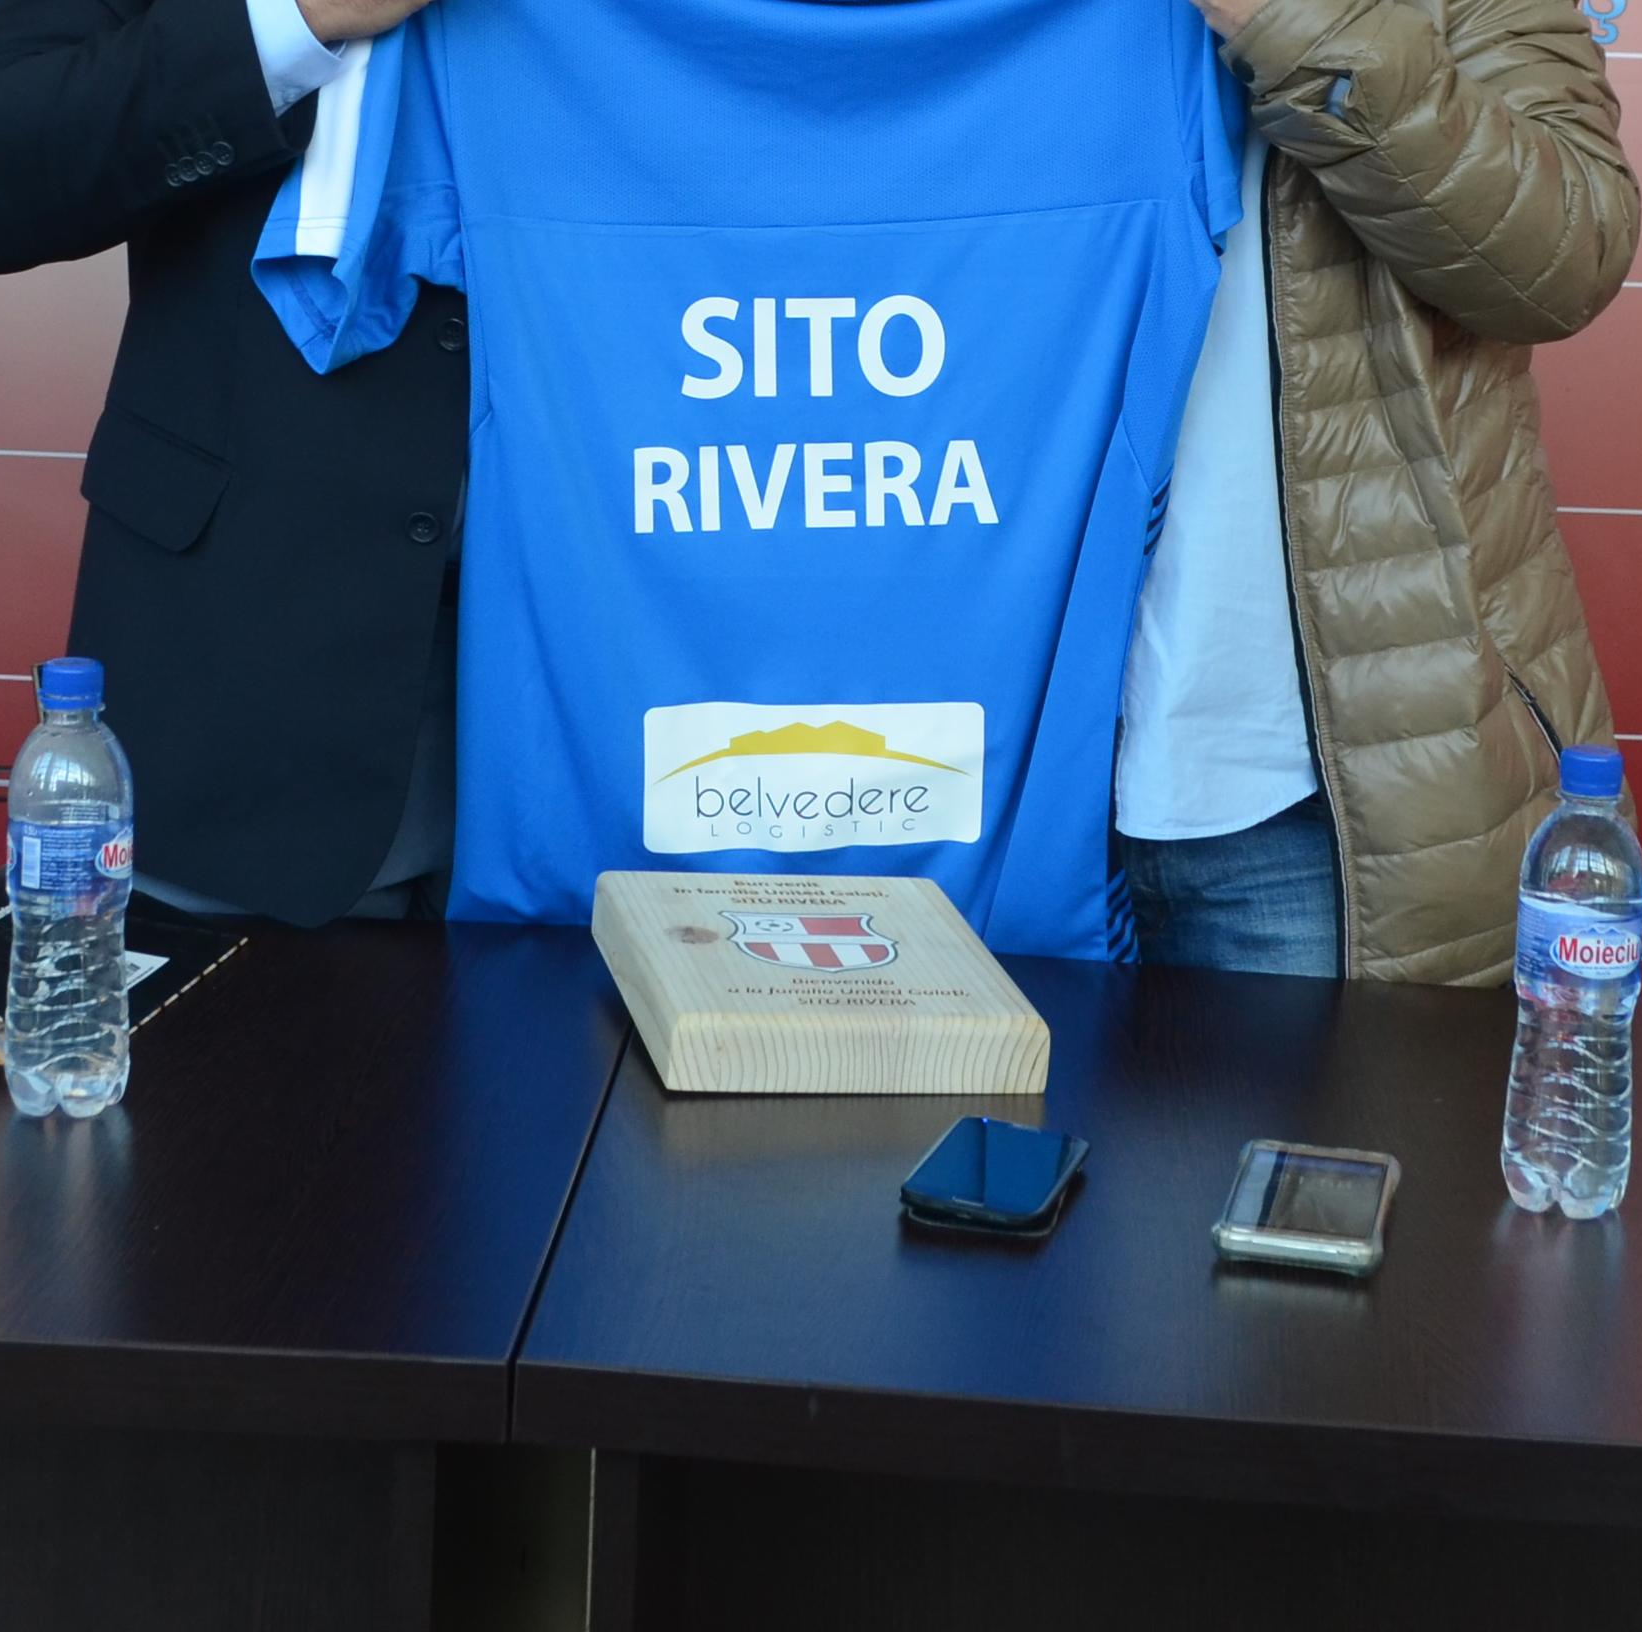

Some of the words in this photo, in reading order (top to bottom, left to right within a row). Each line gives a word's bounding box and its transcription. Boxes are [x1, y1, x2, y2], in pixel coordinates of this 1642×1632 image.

[680, 294, 947, 400] SITO
[632, 439, 1000, 535] RIVERA
[695, 775, 930, 819] belvedere
[709, 817, 918, 841] LOGISTIC
[731, 897, 773, 905] SITO
[777, 898, 847, 906] RIVERA
[764, 887, 826, 897] United
[1558, 934, 1641, 967] Moieciu
[797, 997, 841, 1006] SITO
[846, 997, 917, 1007] RIVERA
[840, 987, 903, 996] United
